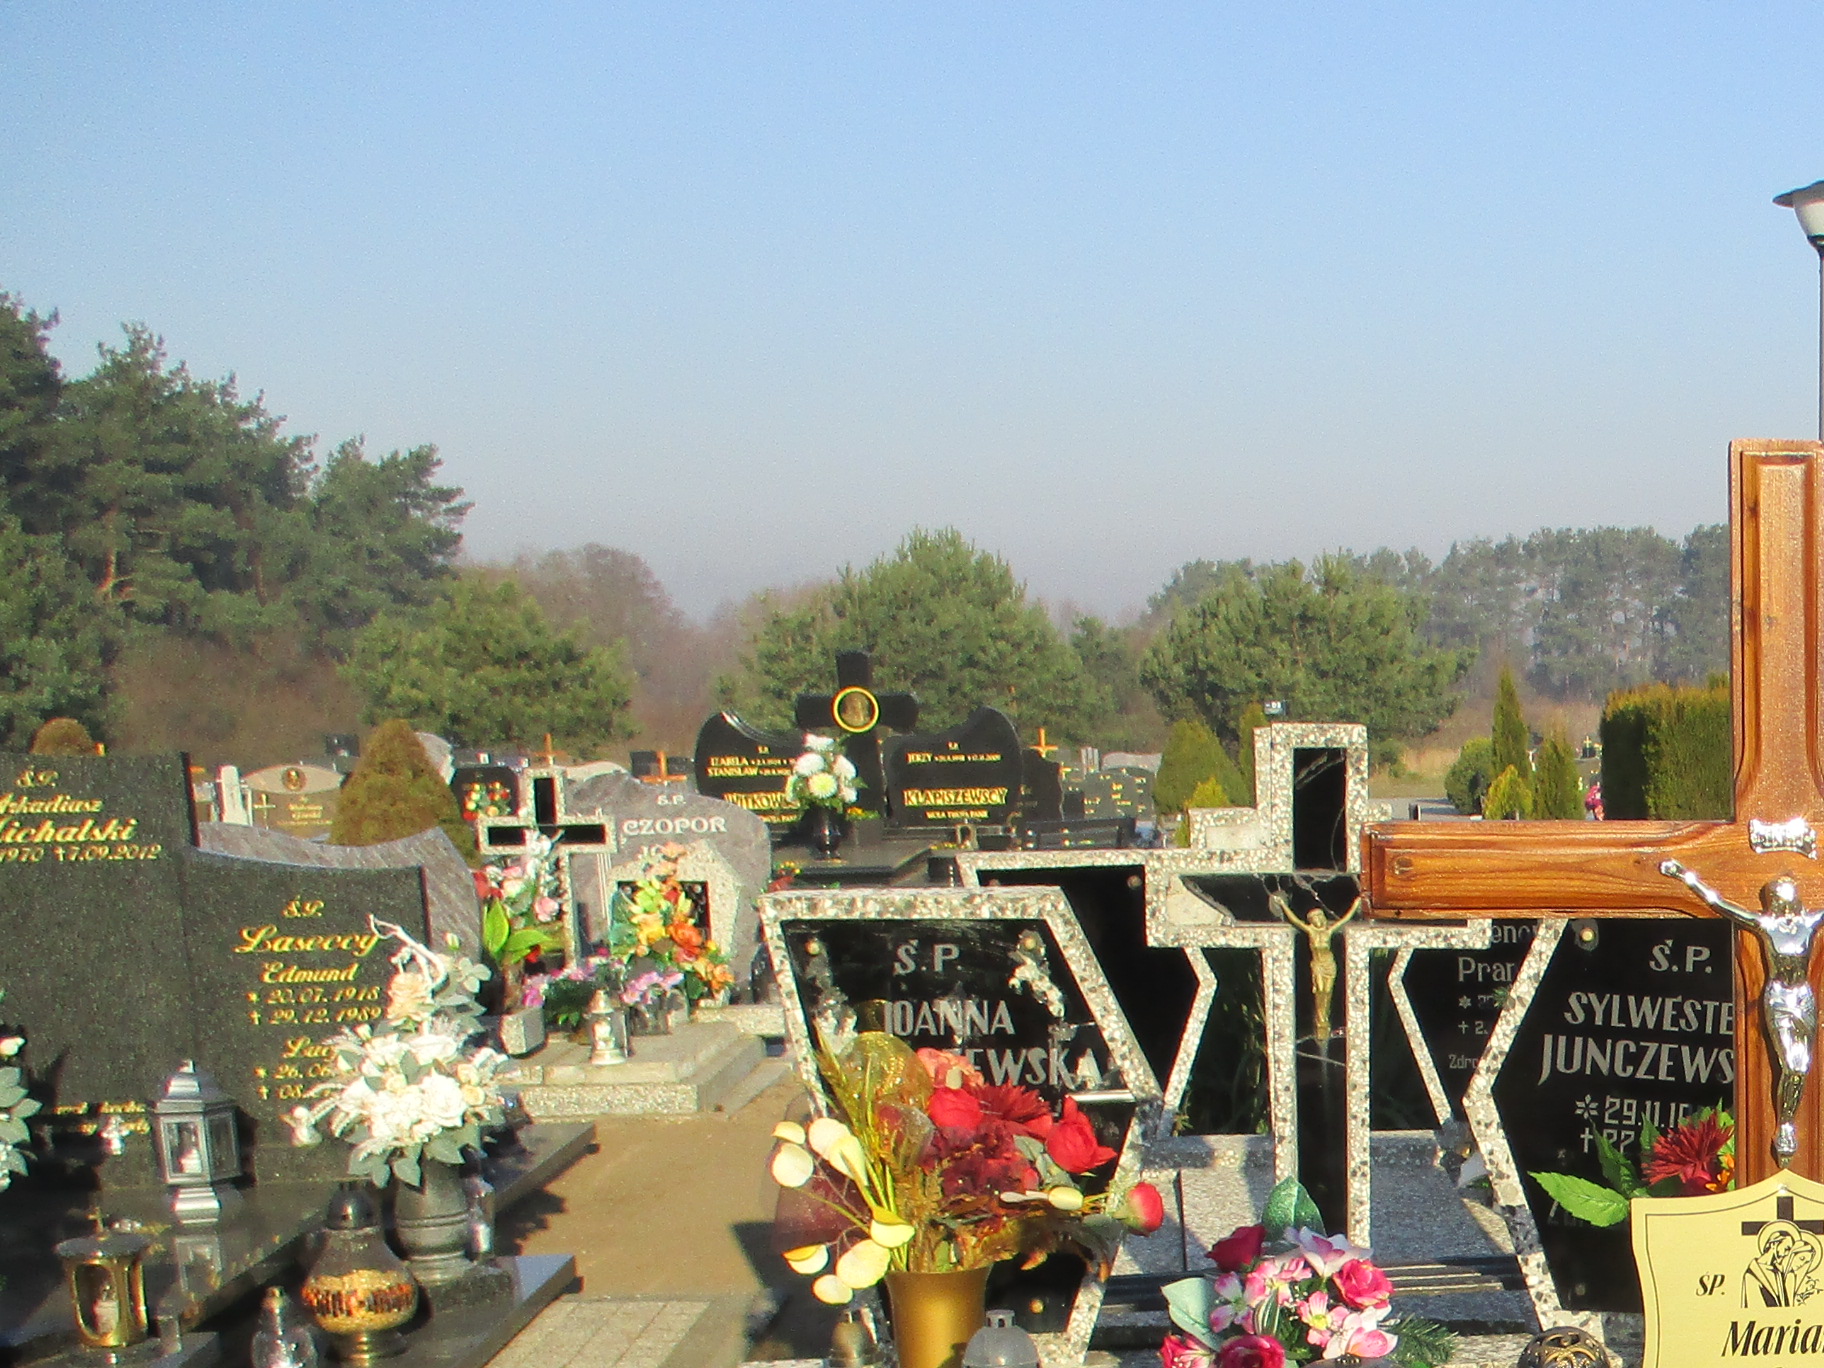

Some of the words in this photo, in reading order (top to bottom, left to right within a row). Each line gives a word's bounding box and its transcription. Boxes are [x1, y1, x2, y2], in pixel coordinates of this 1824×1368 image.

[622, 815, 728, 837] CZOPOR
[1649, 939, 1712, 974] Ś.P.
[259, 962, 360, 983] Edmund
[1537, 1033, 1735, 1087] JUNCZEWS
